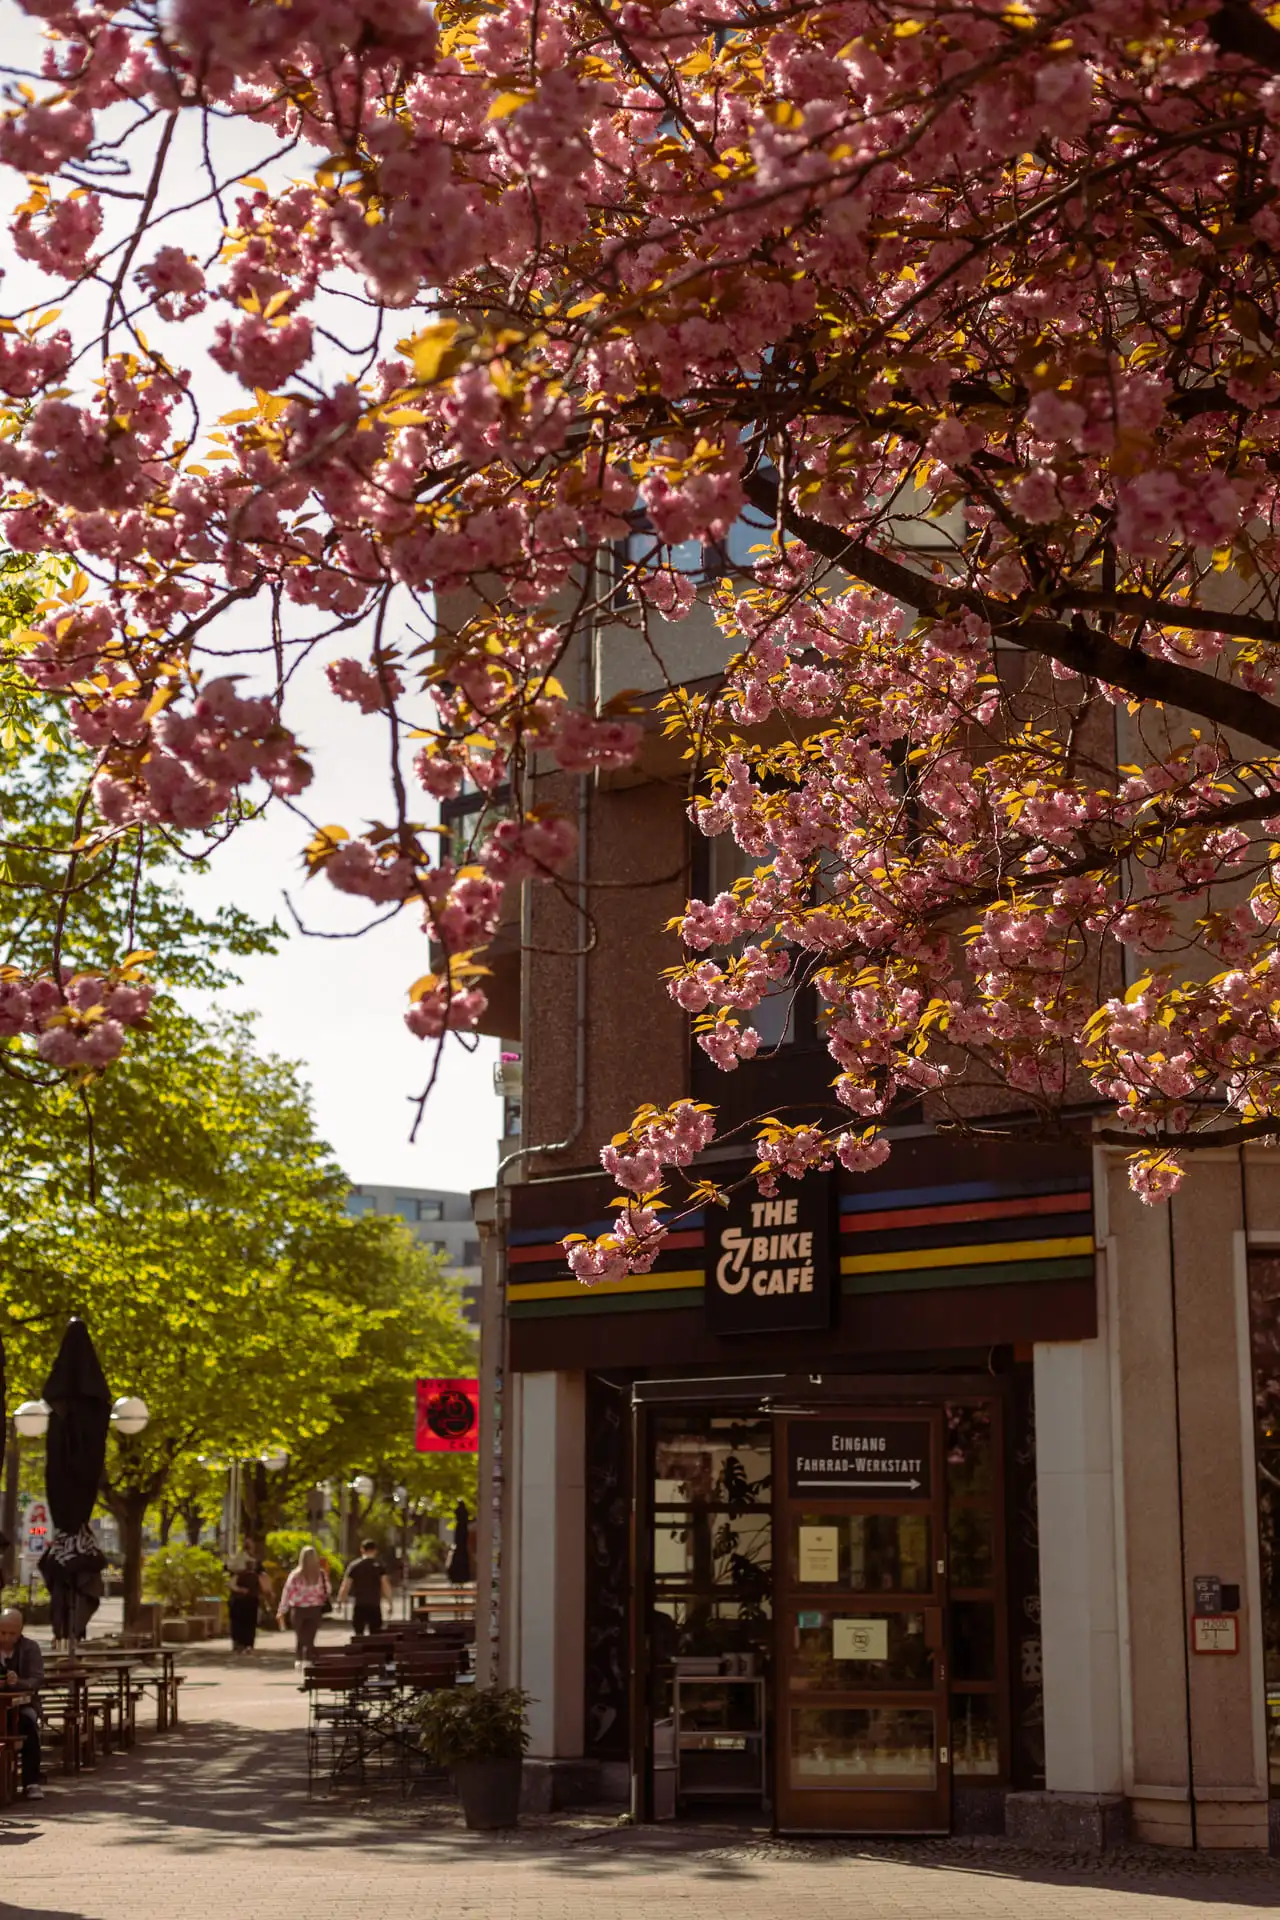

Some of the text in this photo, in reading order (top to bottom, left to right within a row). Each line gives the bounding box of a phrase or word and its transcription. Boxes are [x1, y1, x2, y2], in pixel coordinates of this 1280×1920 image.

[751, 1199, 798, 1228] THE
[752, 1232, 813, 1262] BIKE
[752, 1259, 815, 1296] CAFÉ
[831, 1435, 887, 1452] EINGANG
[796, 1457, 921, 1473] FAHRRAD-WERKSTATT
